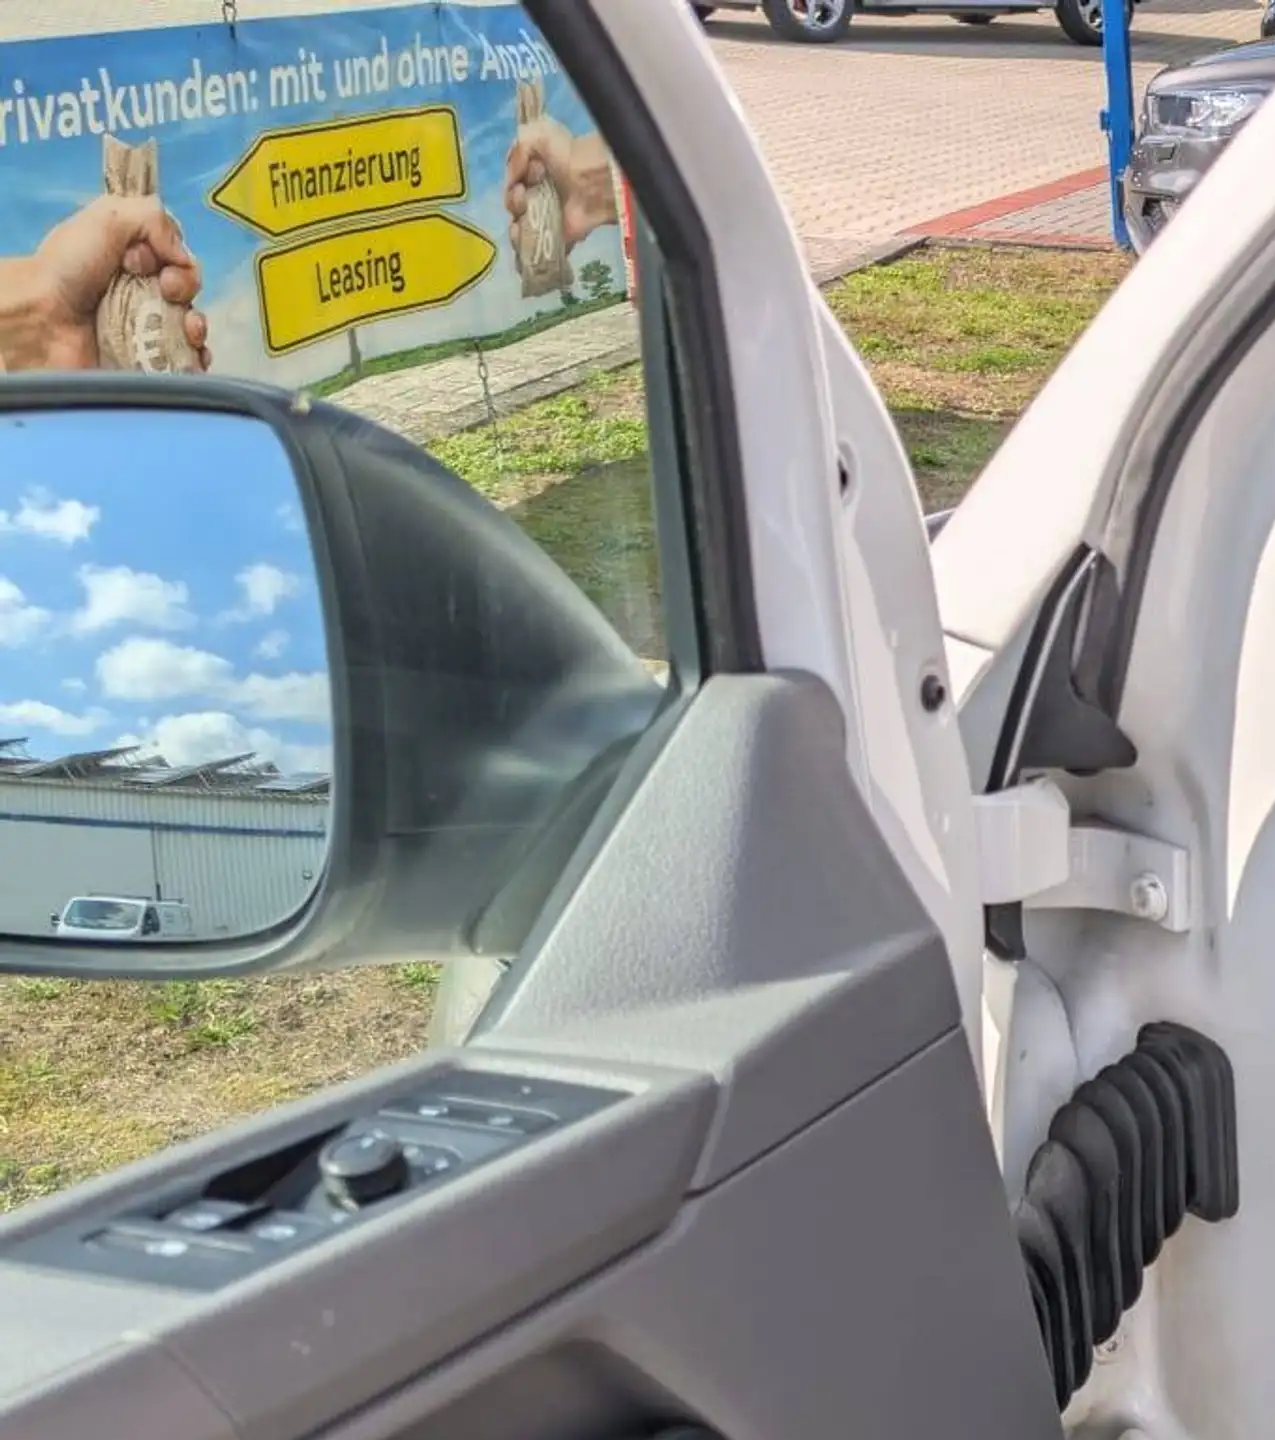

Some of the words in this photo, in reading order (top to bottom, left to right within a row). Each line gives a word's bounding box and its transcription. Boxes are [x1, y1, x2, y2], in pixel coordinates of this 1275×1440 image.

[270, 48, 327, 107] mit
[333, 34, 390, 98] und
[398, 32, 469, 88] ohne
[480, 28, 559, 81] Anzah
[268, 146, 423, 208] Finanzierung
[315, 248, 406, 303] Leasing
